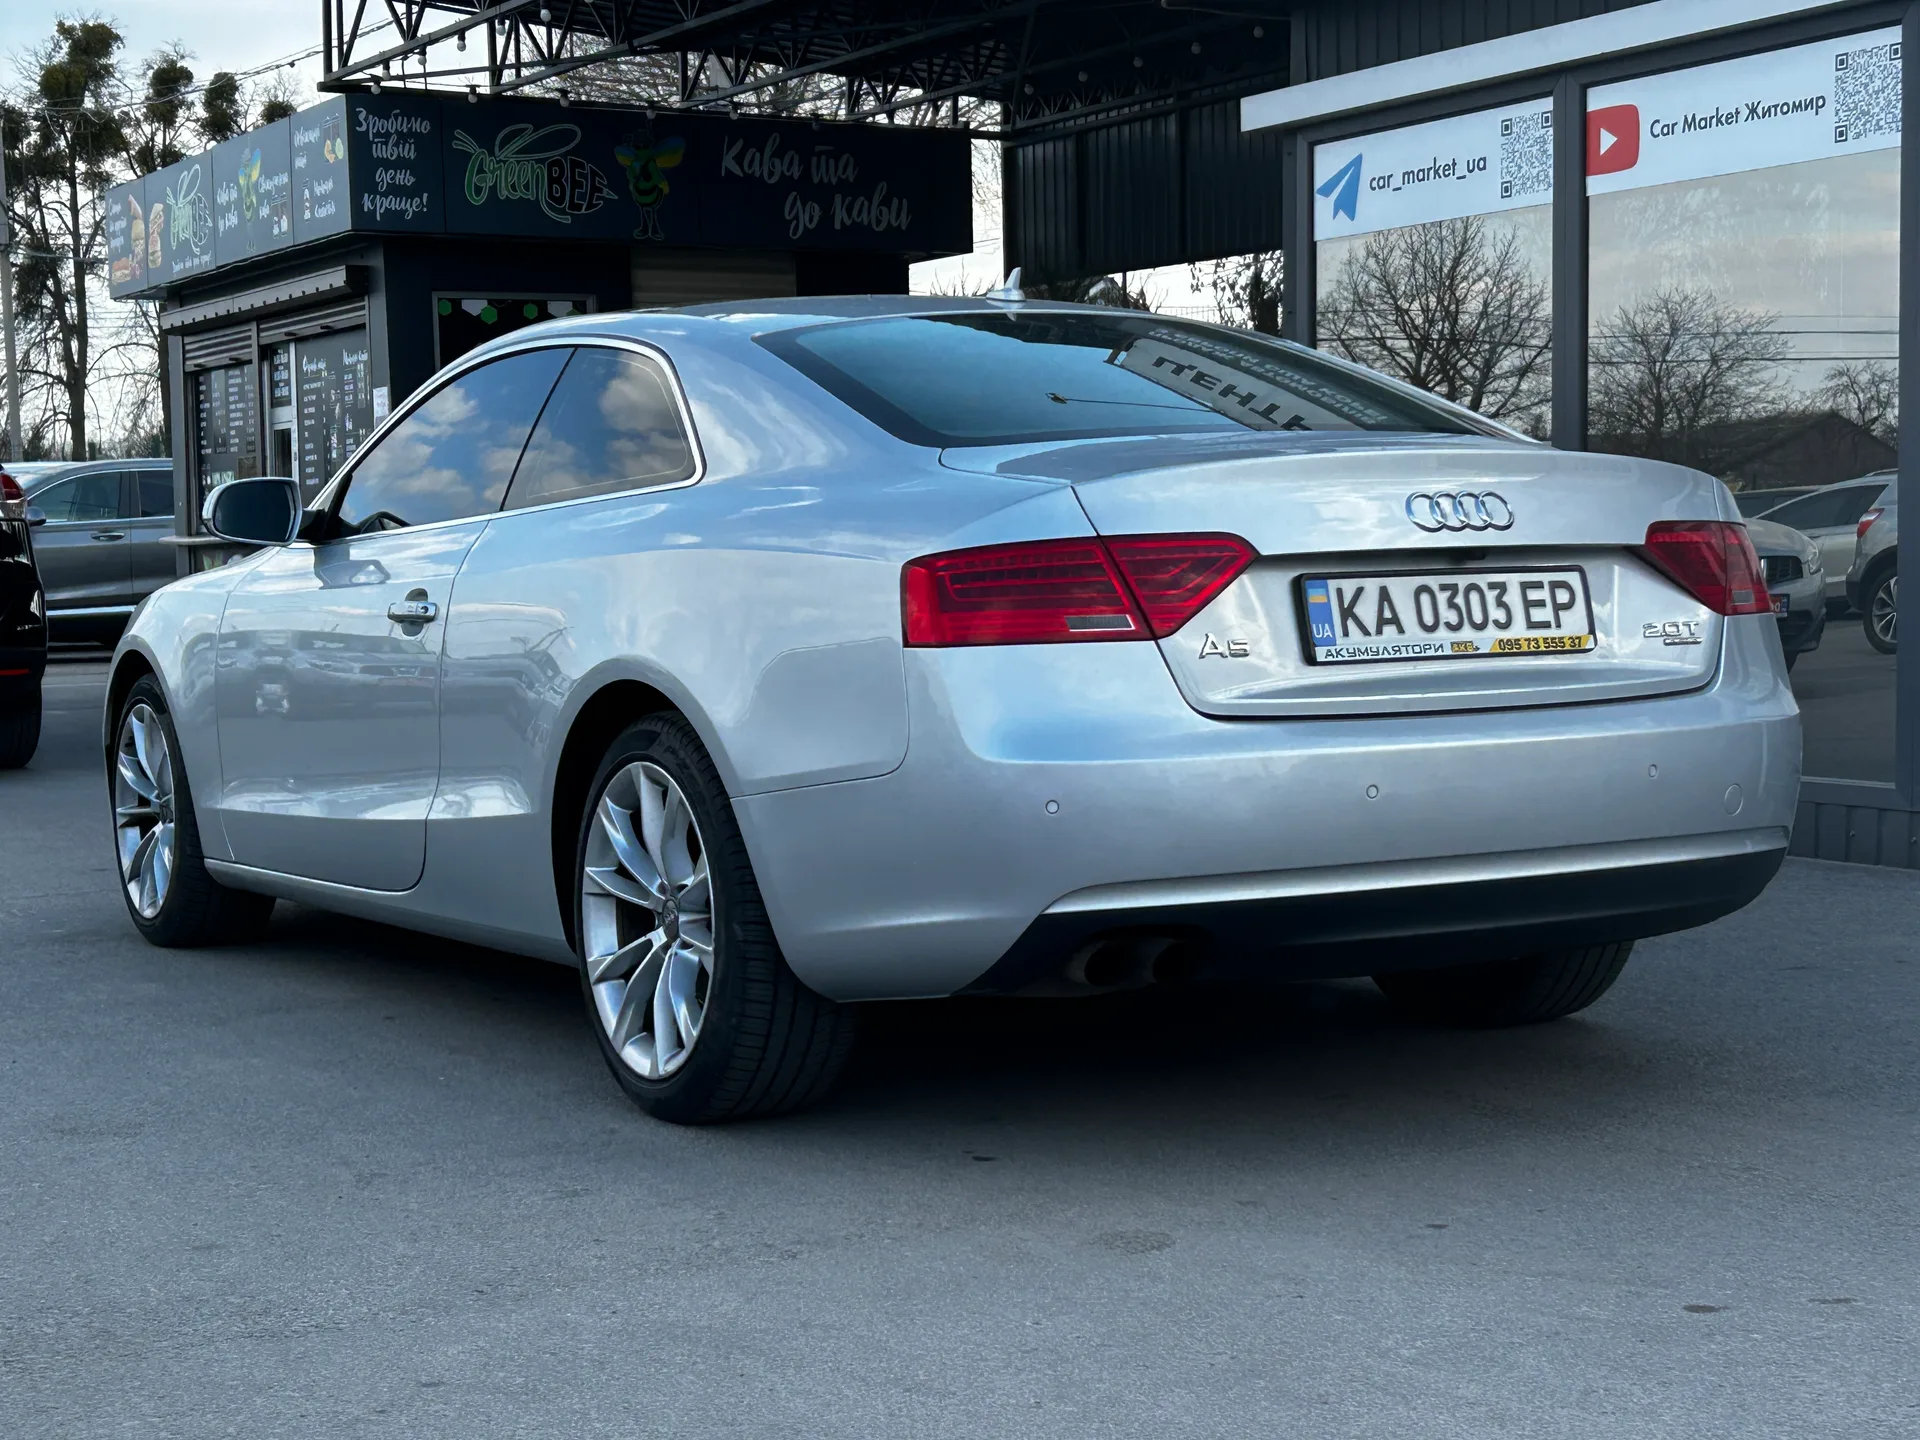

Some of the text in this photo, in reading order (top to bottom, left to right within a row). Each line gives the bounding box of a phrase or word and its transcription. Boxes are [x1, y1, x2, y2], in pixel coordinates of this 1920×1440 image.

[355, 107, 431, 141] Зробимо
[1649, 93, 1827, 140] Car Market Житомир
[371, 135, 417, 161] твій
[720, 132, 860, 185] Кава та
[375, 166, 417, 193] день
[1368, 153, 1487, 194] car_market_ua
[361, 192, 430, 222] краще!
[784, 180, 913, 240] до кави
[1335, 580, 1577, 638] KA 0303 EP
[1311, 623, 1333, 639] UA
[1642, 620, 1700, 638] 2.0T
[1198, 631, 1250, 660] A5
[1324, 642, 1444, 659] АКУМУЛЯТОРИ
[1497, 639, 1523, 651] 095
[1525, 638, 1541, 651] 73
[1543, 637, 1566, 650] 555
[1568, 636, 1583, 649] 37
